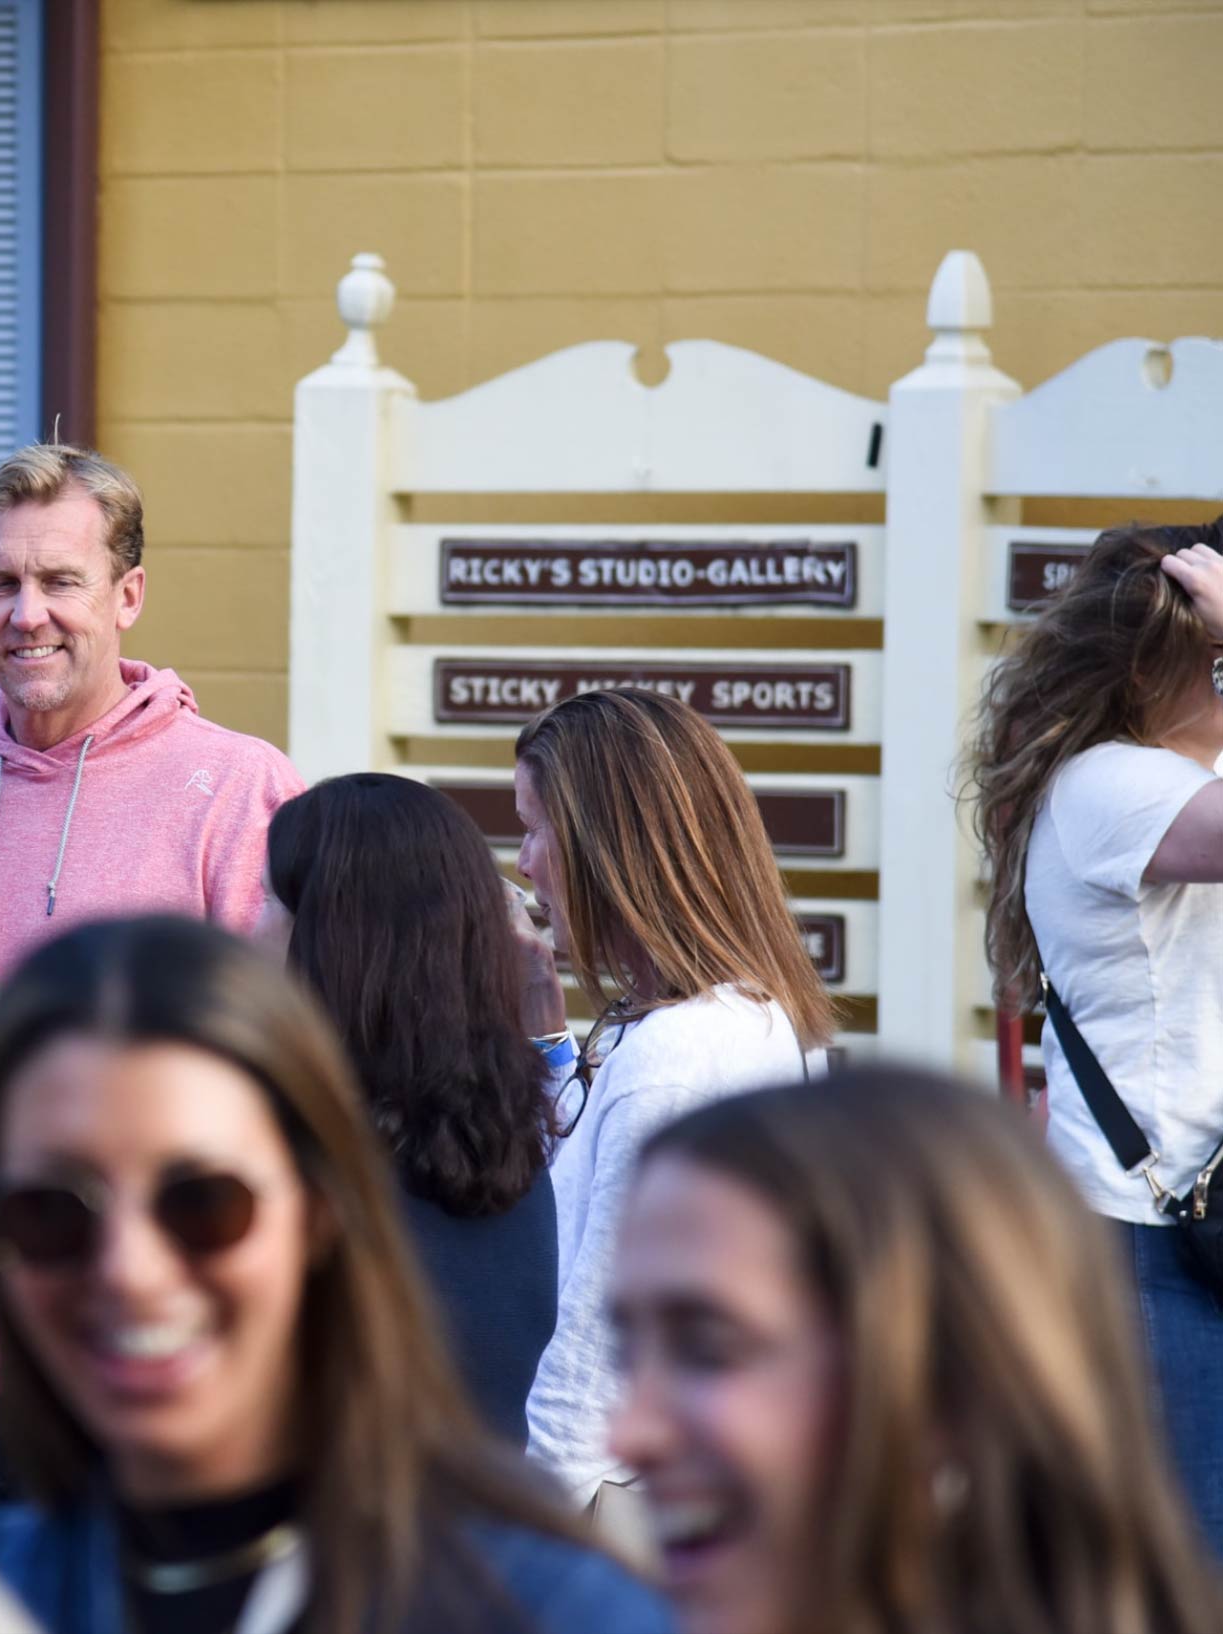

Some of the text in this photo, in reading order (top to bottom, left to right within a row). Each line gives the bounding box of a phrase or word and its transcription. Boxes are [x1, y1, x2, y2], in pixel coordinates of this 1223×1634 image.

[449, 555, 847, 587] RICKY'S STUDIO-GALLERY
[449, 676, 561, 705] STICKY
[711, 680, 836, 711] SPORTS
